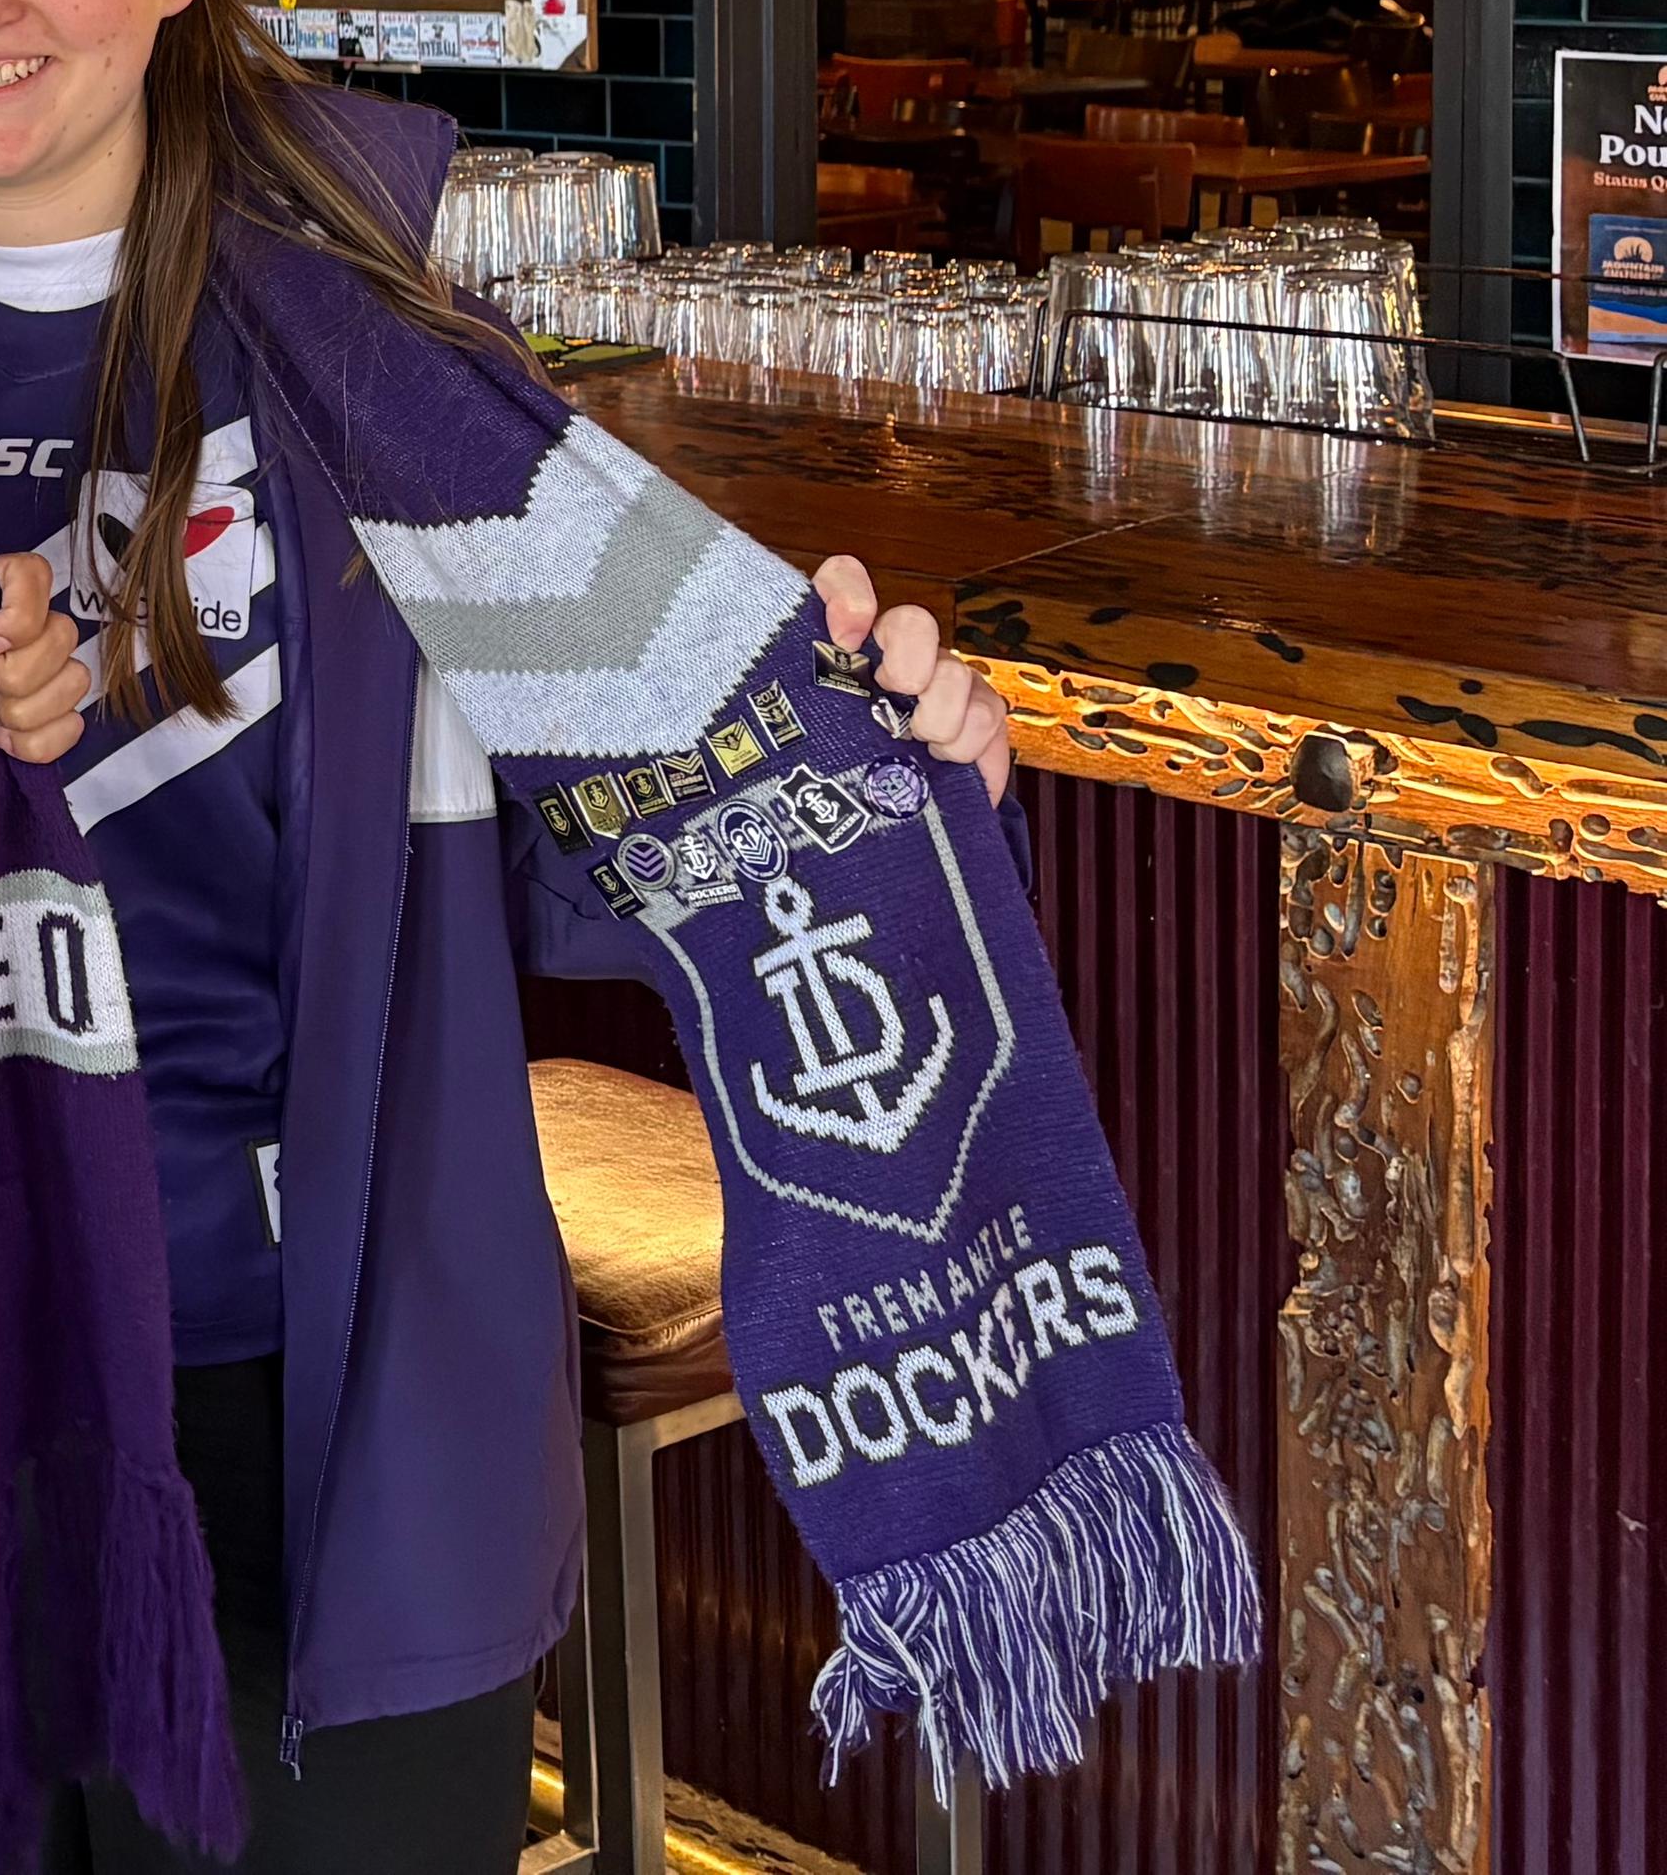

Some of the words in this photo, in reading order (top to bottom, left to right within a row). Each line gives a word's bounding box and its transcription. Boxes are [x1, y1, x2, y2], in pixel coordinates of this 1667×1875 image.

[260, 17, 295, 47] ALE
[1593, 171, 1647, 189] Status
[1602, 259, 1665, 274] MOUNTAIN
[754, 688, 781, 706] 2017
[826, 811, 859, 845] DOCKERS
[687, 884, 738, 901] DOCKERS
[818, 1204, 1034, 1352] FREMANTLE
[762, 1244, 1138, 1489] DOCKERS
